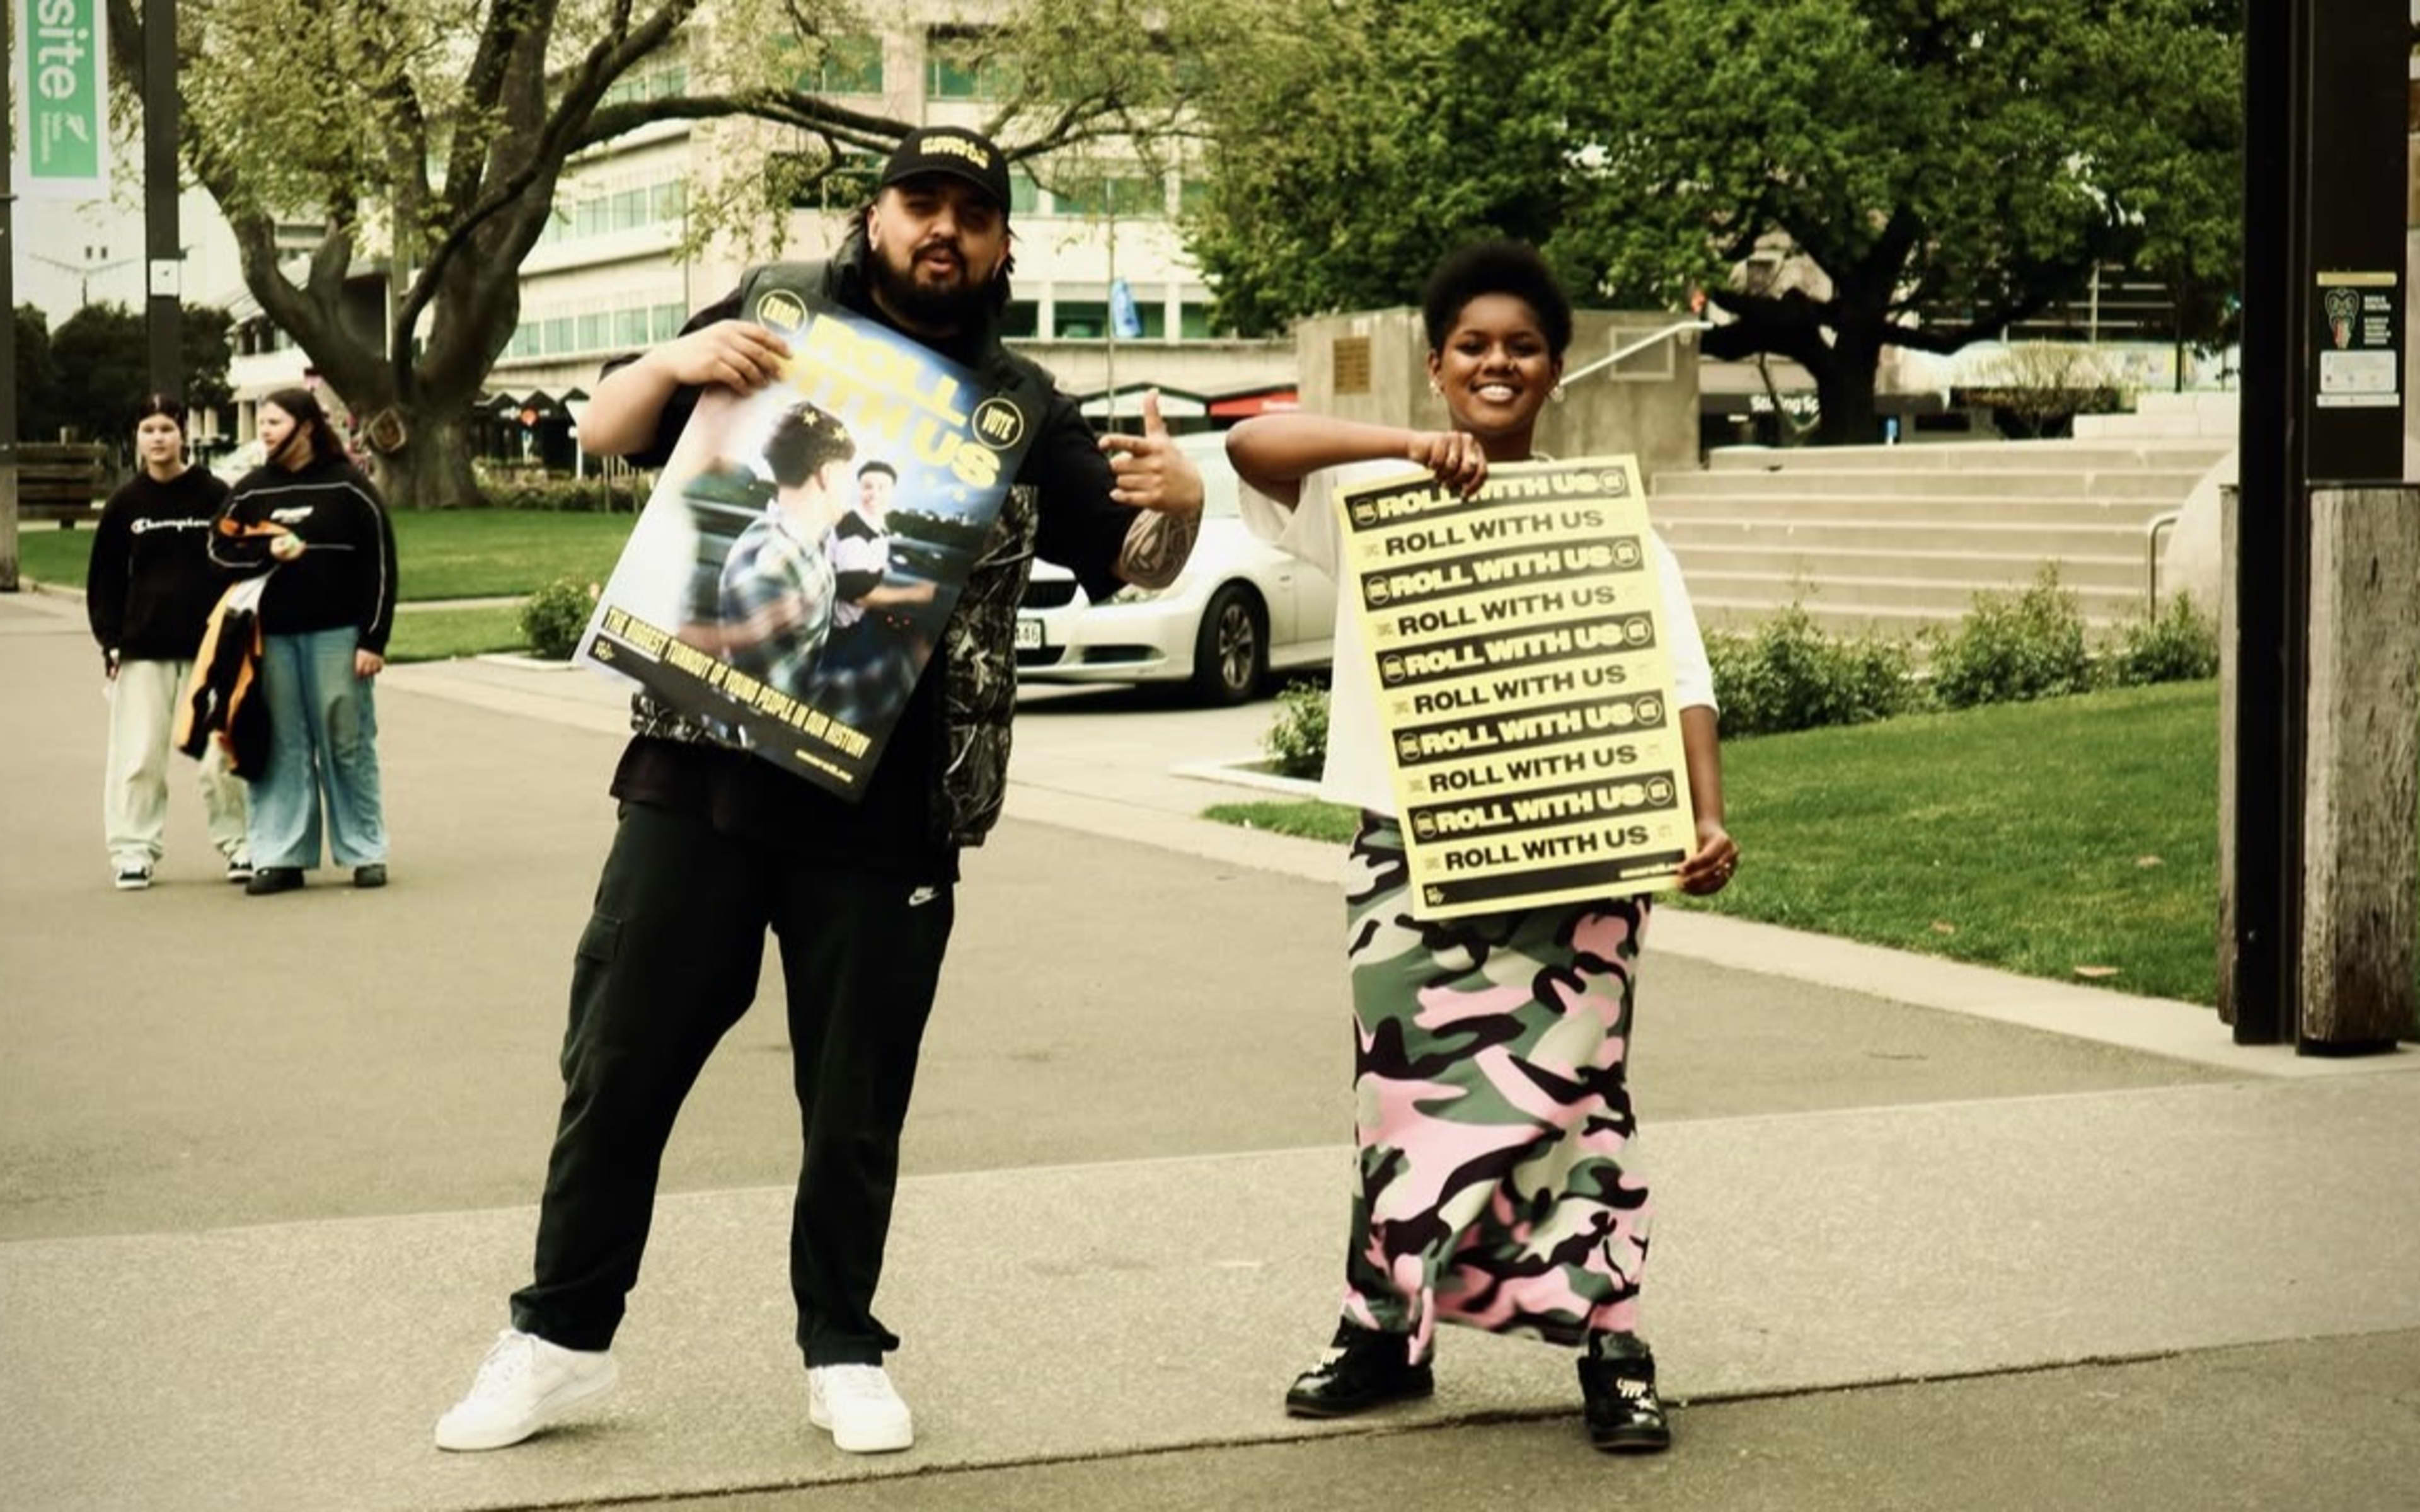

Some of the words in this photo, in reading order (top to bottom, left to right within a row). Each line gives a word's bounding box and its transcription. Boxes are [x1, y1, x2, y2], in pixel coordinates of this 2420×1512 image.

[807, 314, 967, 427] ROLL
[911, 417, 1002, 490] US
[1551, 473, 1599, 494] US
[1386, 527, 1465, 556] ROLL
[1470, 513, 1553, 541] WITH
[1561, 510, 1605, 529] US
[1390, 566, 1473, 597] ROLL
[1473, 550, 1561, 581] WITH
[1563, 545, 1613, 570] US
[1398, 607, 1477, 636] ROLL
[1481, 592, 1564, 621] WITH
[1572, 585, 1615, 607] US
[1405, 645, 1485, 677] ROLL
[1484, 628, 1572, 663] WITH
[1575, 623, 1623, 650] US
[1414, 686, 1489, 714] ROLL
[1493, 671, 1574, 701] WITH
[1582, 664, 1627, 687] US
[1420, 725, 1499, 754] ROLL
[1498, 709, 1582, 742] WITH
[1585, 702, 1634, 729] US
[1429, 765, 1504, 793] ROLL
[1506, 752, 1585, 781] WITH
[1593, 745, 1637, 767] US
[1436, 804, 1512, 833] ROLL
[1512, 790, 1594, 822] WITH
[1596, 783, 1645, 810] US
[1445, 844, 1519, 871] ROLL
[1522, 832, 1598, 860] WITH
[1605, 825, 1649, 848] US
